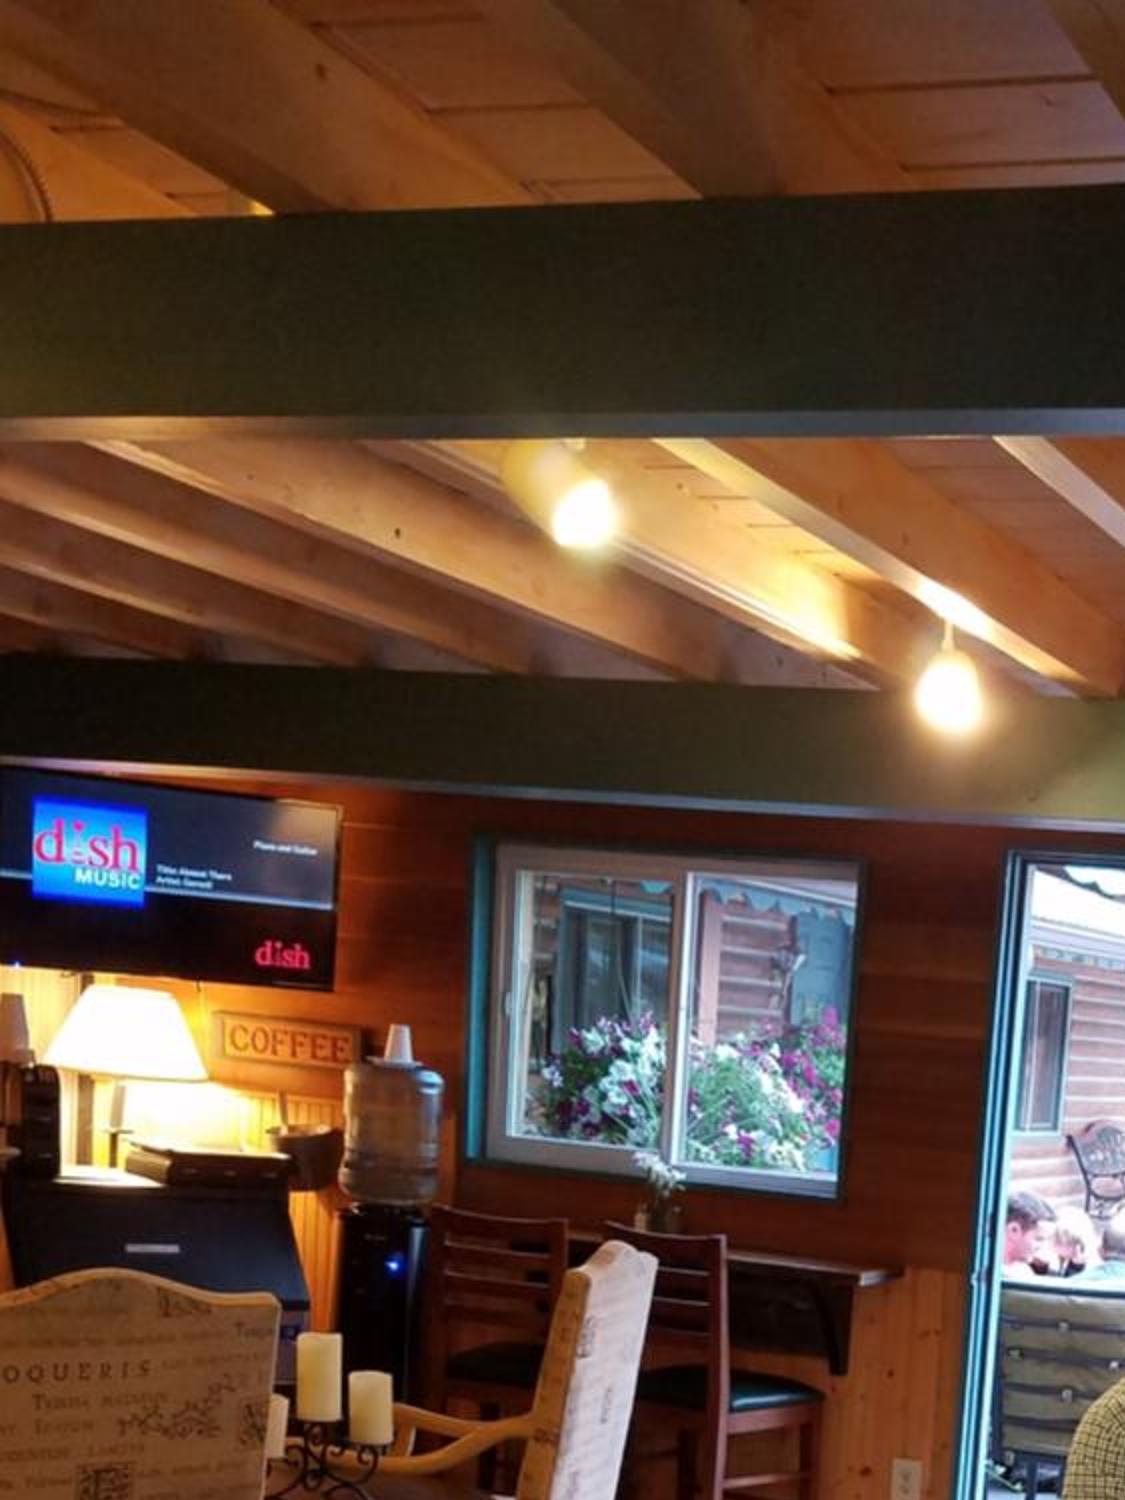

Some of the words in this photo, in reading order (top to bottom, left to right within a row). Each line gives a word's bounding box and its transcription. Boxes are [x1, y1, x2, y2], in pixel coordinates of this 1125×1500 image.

[33, 818, 141, 872] dish
[75, 867, 141, 889] MUSIC
[255, 939, 310, 970] dish
[229, 1023, 351, 1063] COFFEE
